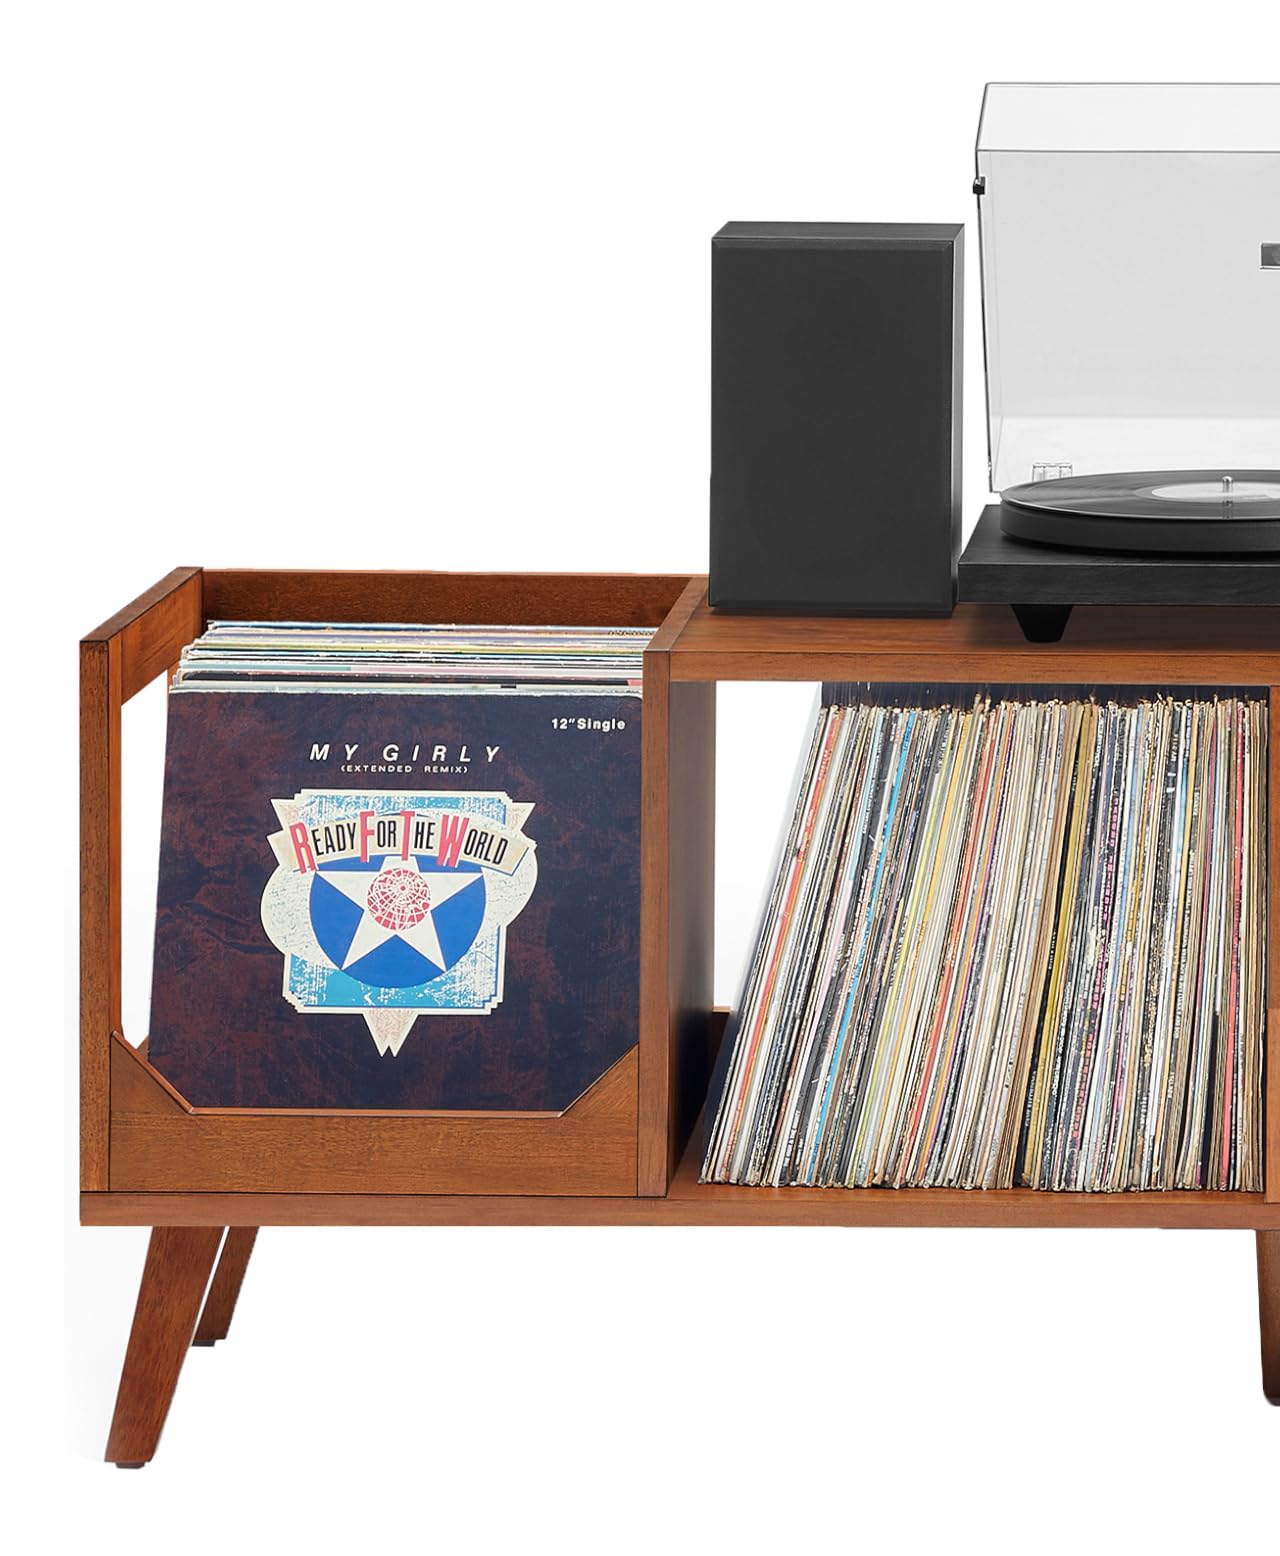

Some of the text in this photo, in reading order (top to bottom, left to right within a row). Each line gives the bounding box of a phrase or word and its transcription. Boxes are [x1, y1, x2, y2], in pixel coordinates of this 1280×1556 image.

[309, 743, 502, 763] MY GIRLY
[340, 764, 469, 774] (EXTENDED REMIX)
[289, 810, 509, 874] READY FOR THE WORLD
